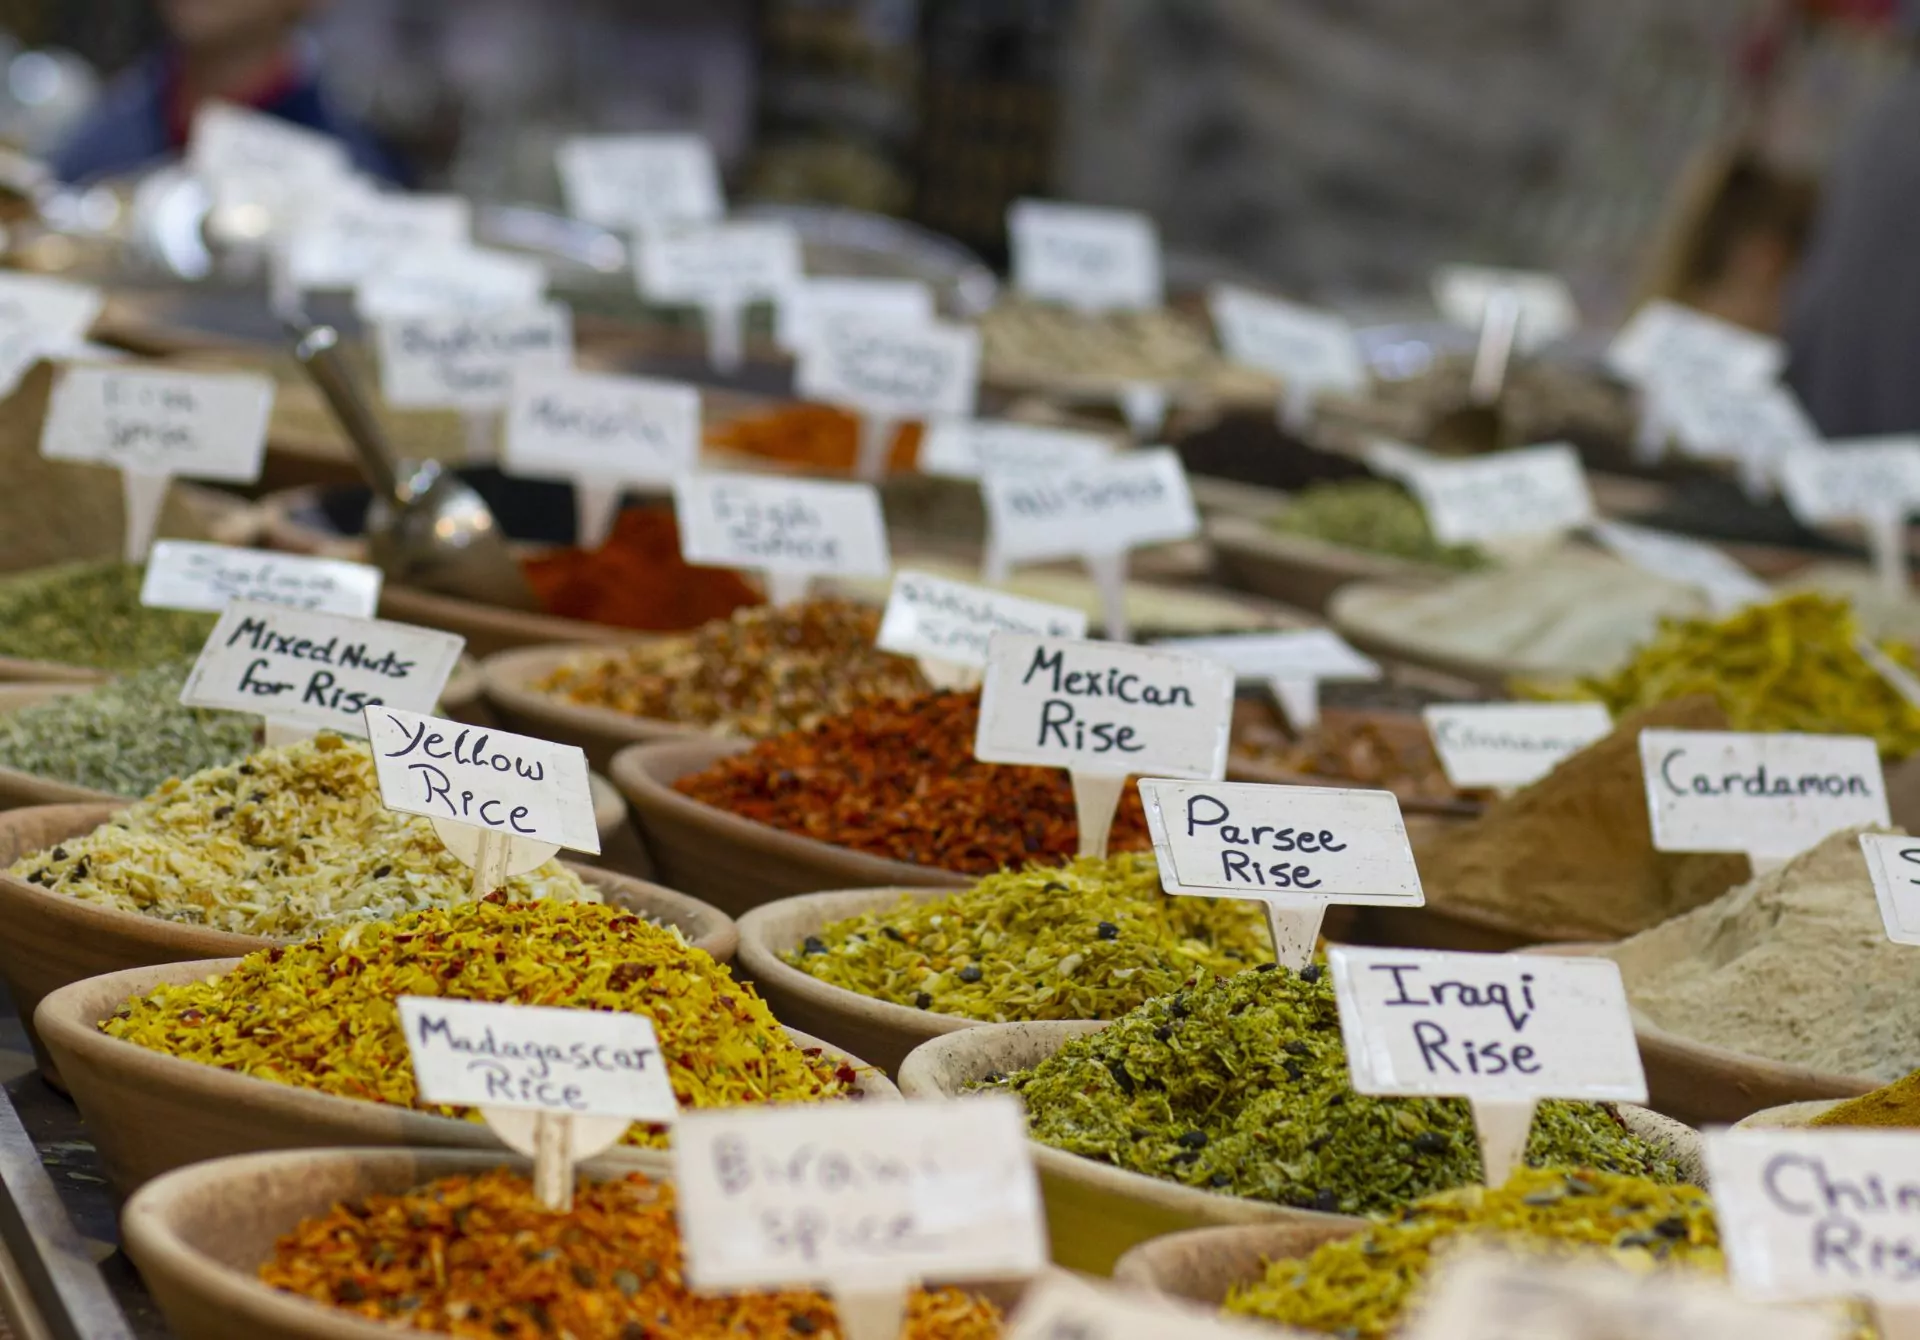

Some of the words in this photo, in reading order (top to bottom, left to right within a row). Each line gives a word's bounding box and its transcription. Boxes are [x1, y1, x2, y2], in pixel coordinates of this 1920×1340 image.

[226, 617, 339, 663] Mixed
[338, 644, 415, 680] Nuts
[1022, 645, 1195, 708] Mexican
[237, 659, 294, 696] for
[302, 670, 385, 713] Rise
[384, 713, 544, 781] Yellow
[1038, 699, 1146, 753] Rise
[407, 763, 537, 833] Rice
[1661, 748, 1873, 797] Cardamon
[1186, 794, 1348, 853] Parsee
[1220, 849, 1322, 889] Rise
[1368, 964, 1535, 1032] Iraqi
[417, 1012, 653, 1079] Madagascar
[1412, 1020, 1542, 1074] Rise
[466, 1058, 589, 1111] Rice
